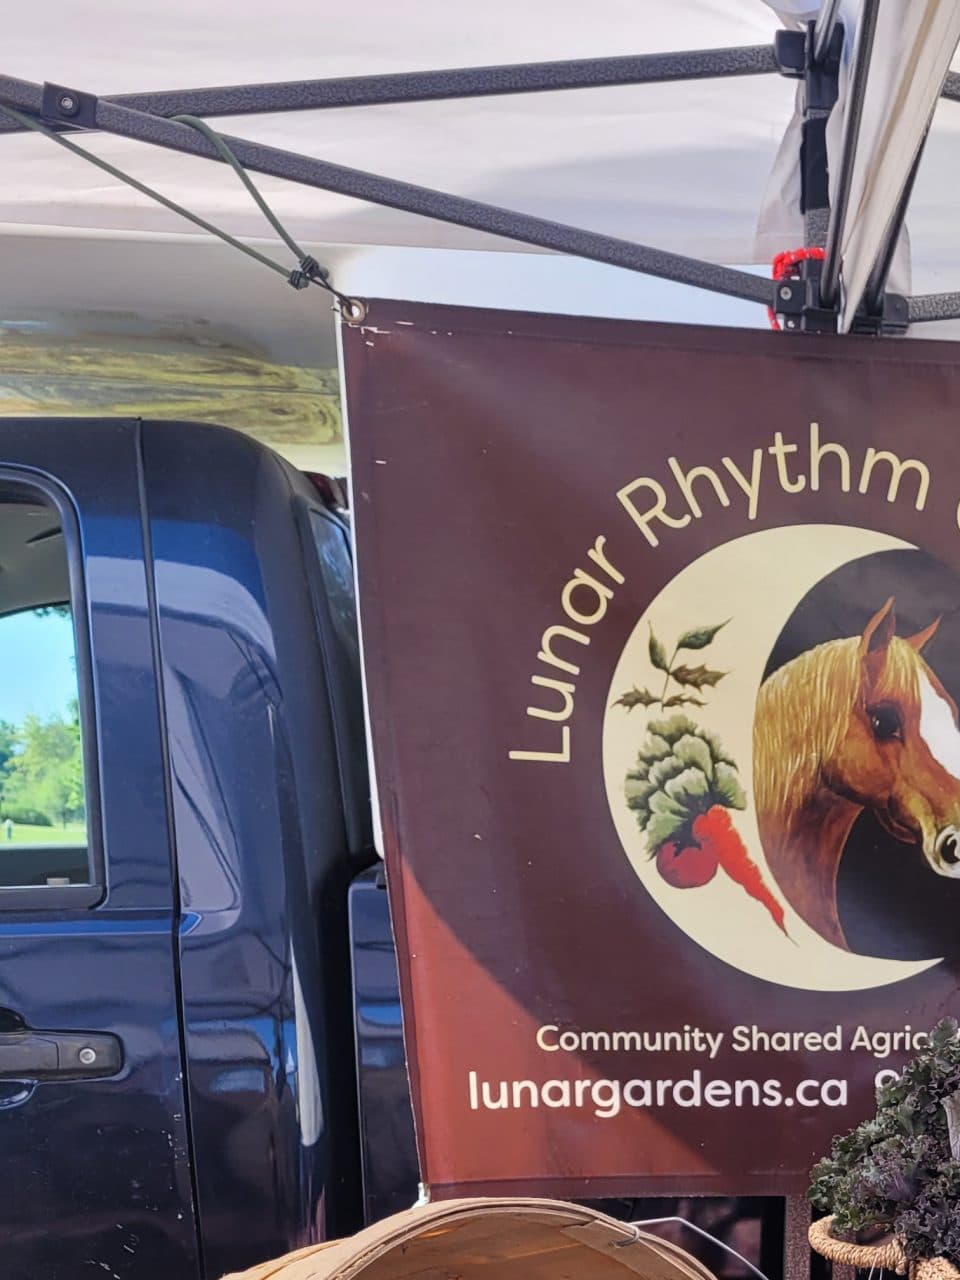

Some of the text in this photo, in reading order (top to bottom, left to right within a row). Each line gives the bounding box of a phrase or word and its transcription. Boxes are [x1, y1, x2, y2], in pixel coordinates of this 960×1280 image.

[508, 535, 626, 764] Lunar
[615, 422, 931, 548] Rhythm
[536, 1024, 724, 1059] Community
[731, 1024, 843, 1052] Shared
[468, 1069, 848, 1118] lunargardens.ca
